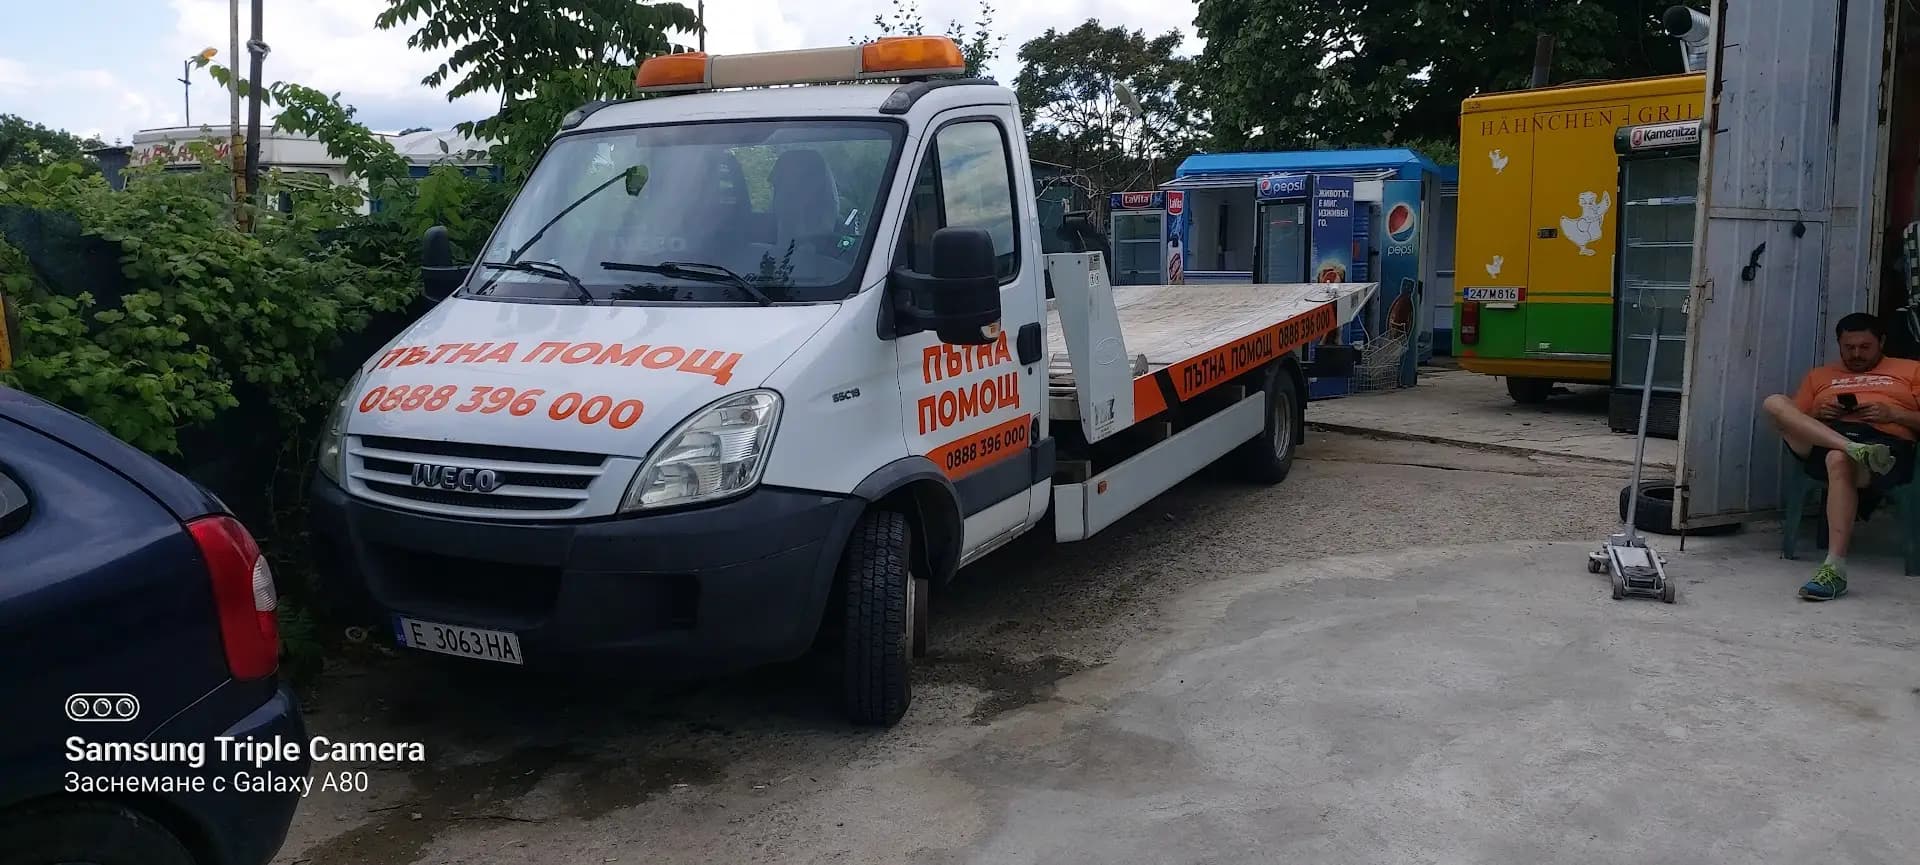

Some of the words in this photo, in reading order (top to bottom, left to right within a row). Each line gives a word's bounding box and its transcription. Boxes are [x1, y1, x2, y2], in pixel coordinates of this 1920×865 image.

[1480, 110, 1613, 137] HÄHNCHEN
[1643, 127, 1697, 142] Kamenitza
[1124, 193, 1149, 204] LaVita
[1272, 179, 1304, 194] pepsi
[1318, 189, 1350, 198] ЖИВОТЪТ
[1318, 208, 1349, 217] ИЗЖИВЕЙ
[1387, 244, 1414, 256] pepsi
[367, 342, 520, 375] ПЪТНА
[520, 341, 744, 386] ПОМОЩ
[923, 330, 1012, 384] ПЪТНА
[1184, 353, 1227, 394] ПЪТНА
[1231, 332, 1273, 373] ПОМОЩ
[1278, 324, 1299, 349] 0888
[1300, 316, 1315, 340] 396
[1316, 310, 1330, 333] 000
[359, 384, 458, 413] 0888
[455, 386, 547, 416] 396
[548, 392, 644, 430] 000
[918, 371, 1020, 436] ПОМОЩ
[946, 443, 977, 471] 0888
[979, 436, 1002, 457] 396
[1004, 425, 1025, 448] 000
[410, 463, 499, 493] IVECO
